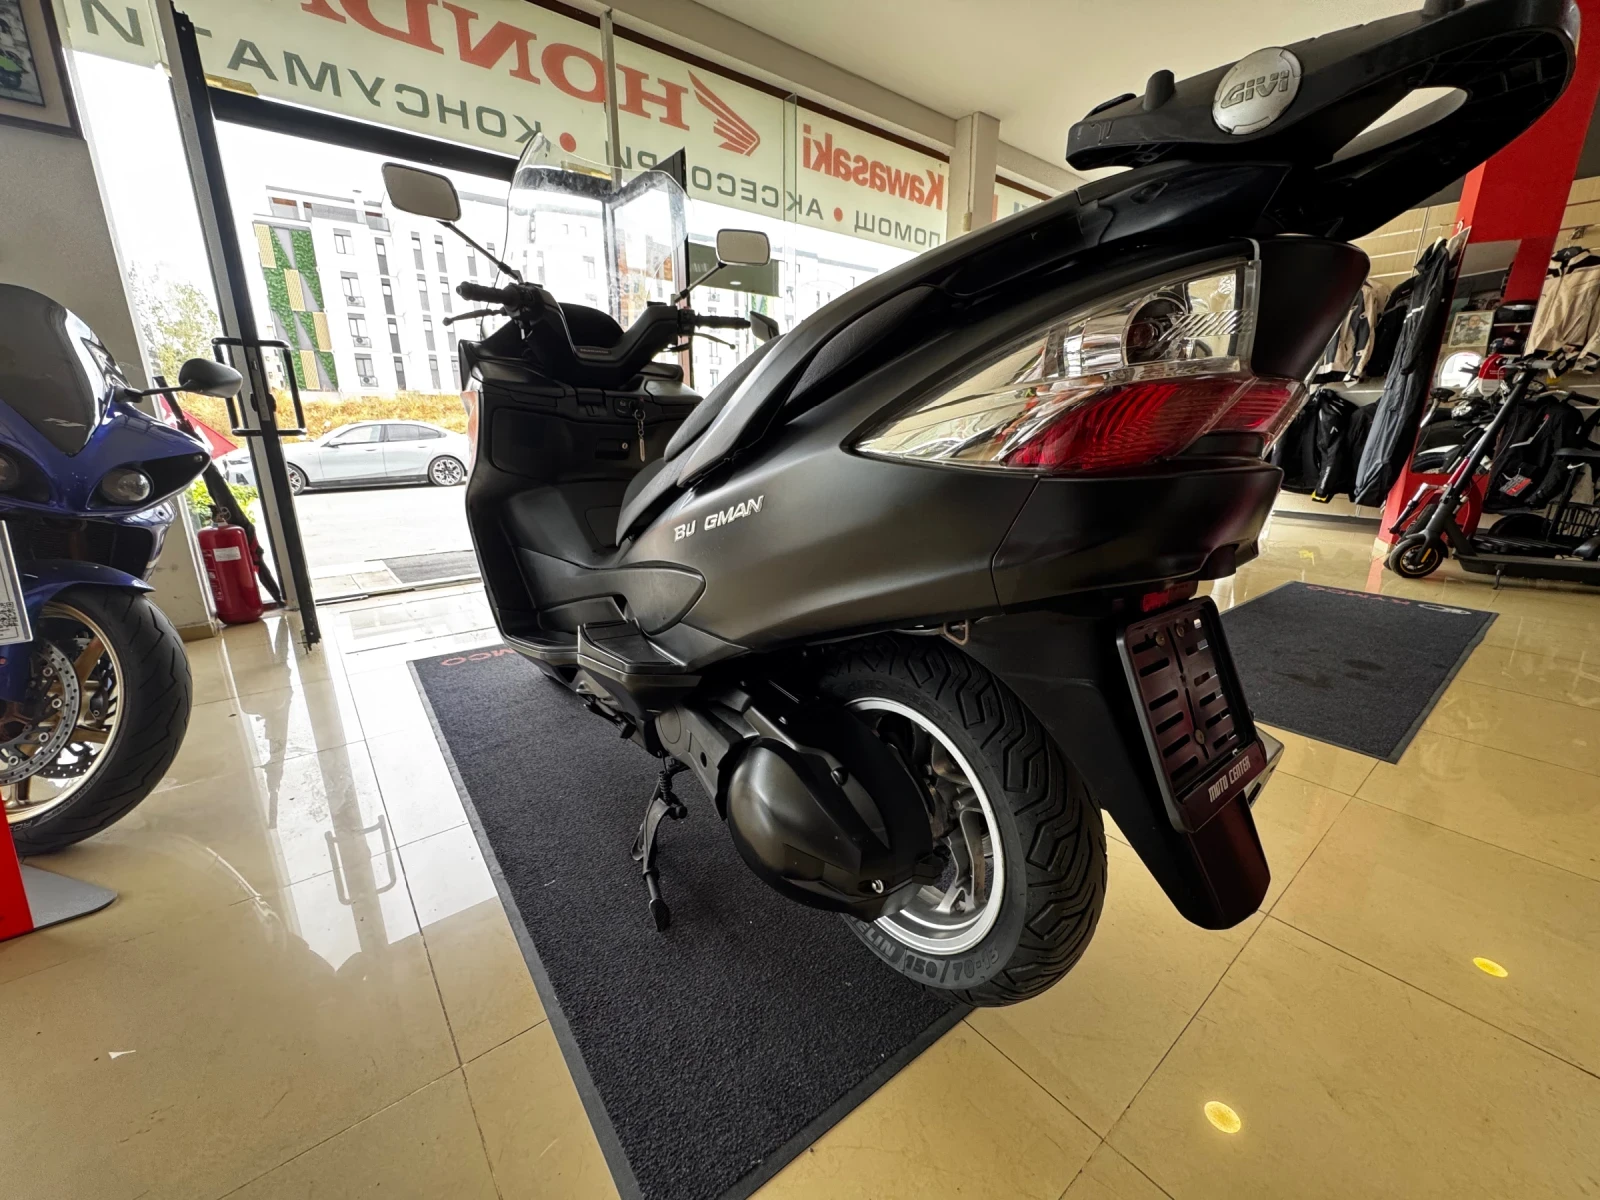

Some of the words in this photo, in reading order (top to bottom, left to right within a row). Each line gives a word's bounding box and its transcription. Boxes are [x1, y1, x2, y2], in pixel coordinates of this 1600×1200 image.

[673, 519, 697, 543] BU
[703, 494, 765, 531] GMAN
[851, 913, 897, 957] ELIN
